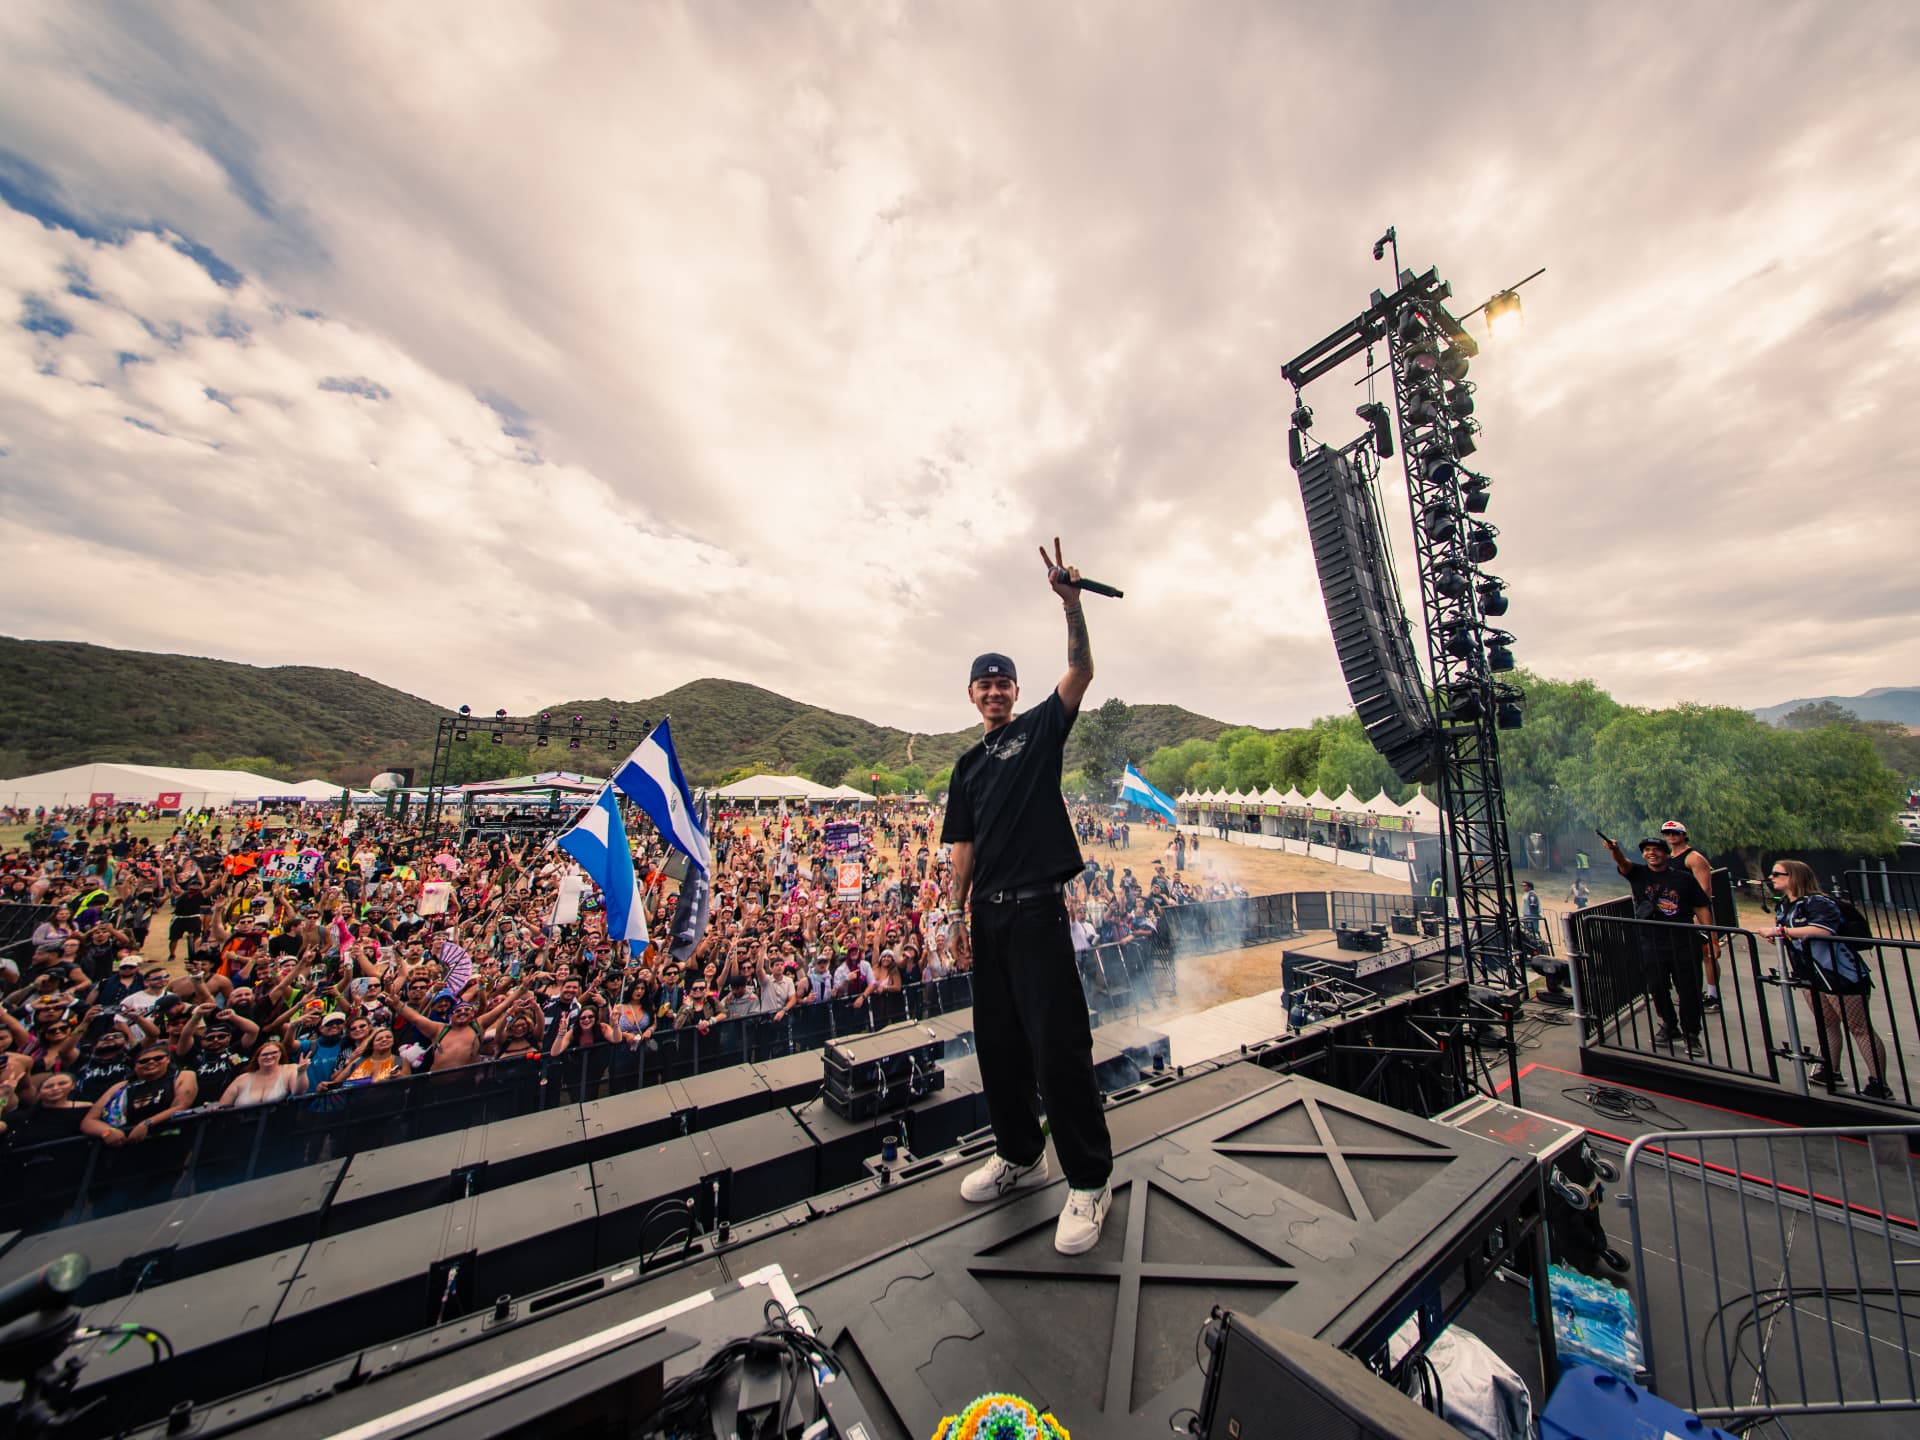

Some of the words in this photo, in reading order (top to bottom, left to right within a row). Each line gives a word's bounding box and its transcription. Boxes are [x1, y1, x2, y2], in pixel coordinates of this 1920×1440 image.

[298, 856, 311, 864] IS
[277, 862, 304, 871] FOR
[264, 869, 314, 880] HORSES
